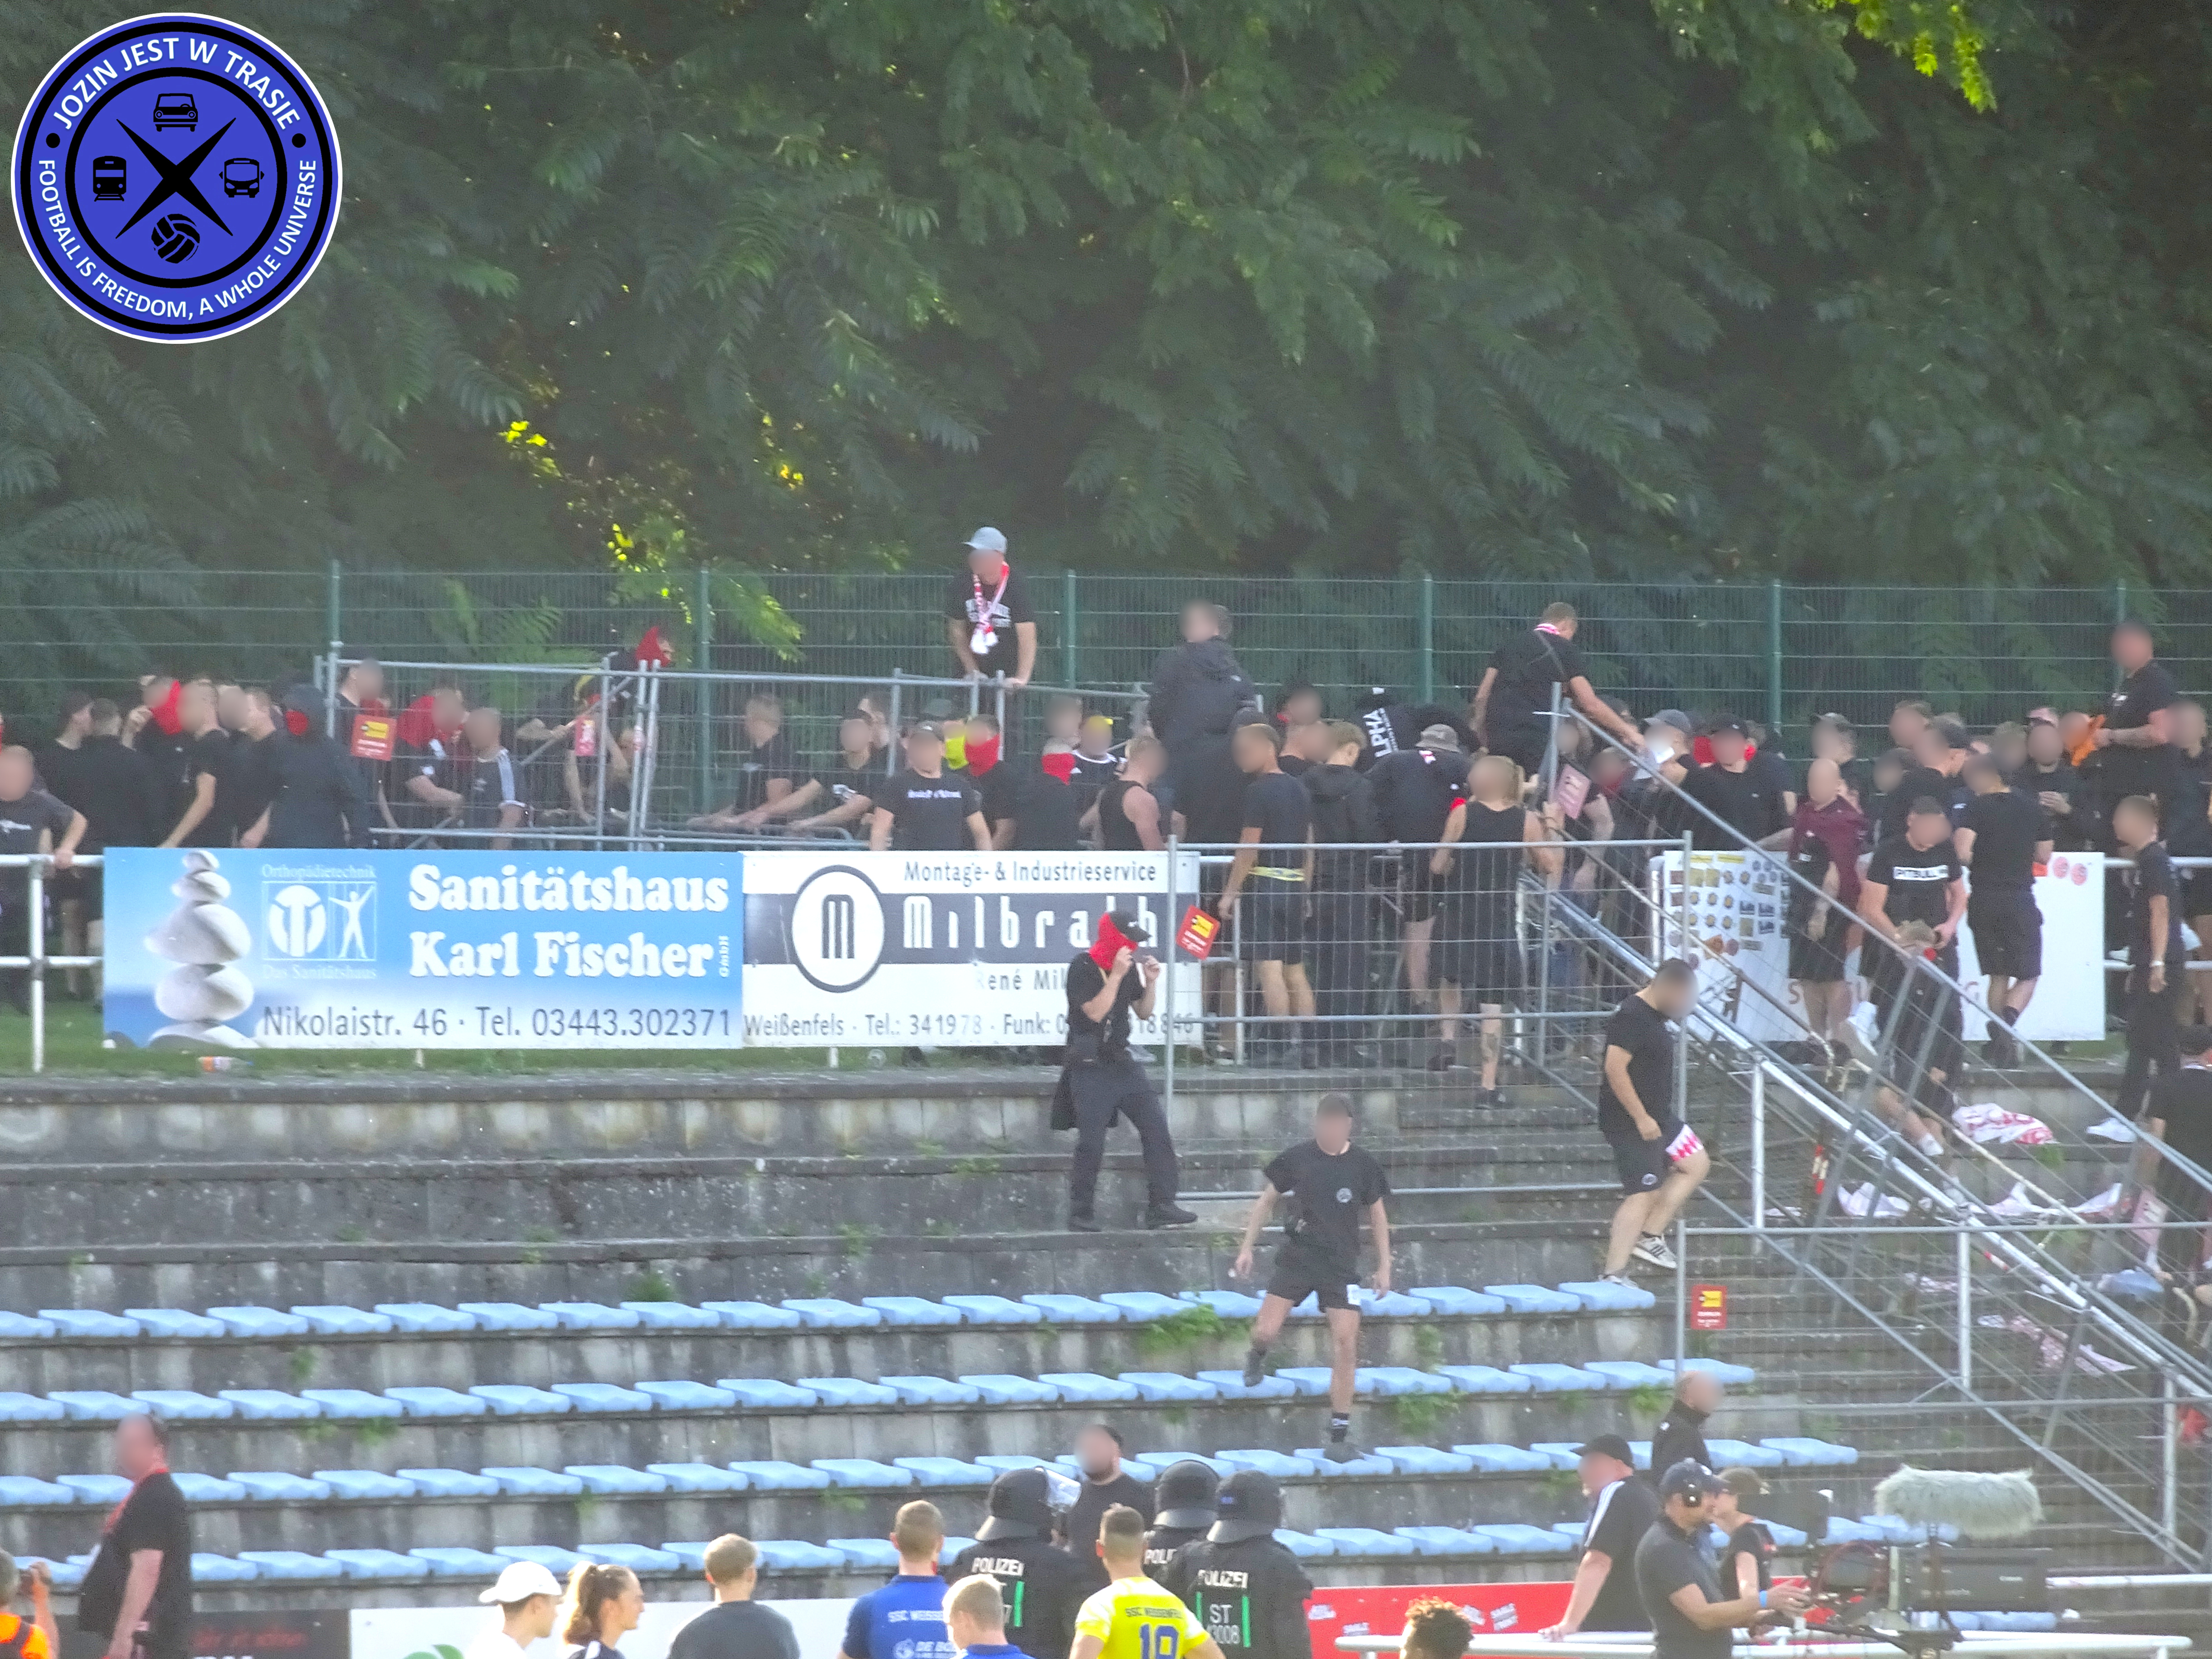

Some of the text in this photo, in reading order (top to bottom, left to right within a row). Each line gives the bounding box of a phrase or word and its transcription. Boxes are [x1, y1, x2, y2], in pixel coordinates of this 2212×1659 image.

[904, 861, 1157, 887] Montage- & Industrieservice
[408, 863, 728, 912] Sanitätshaus
[409, 931, 714, 977] Karl Fischer
[263, 1006, 730, 1037] Nikolaistr. 46 Tel. 03443.302371
[744, 1012, 844, 1036] Weißenfels
[910, 1013, 982, 1036] 341978
[1003, 1012, 1050, 1035] Funk:
[972, 1557, 1025, 1577] POLIZEI
[1198, 1570, 1249, 1589] POLIZEI
[1209, 1604, 1233, 1624] ST
